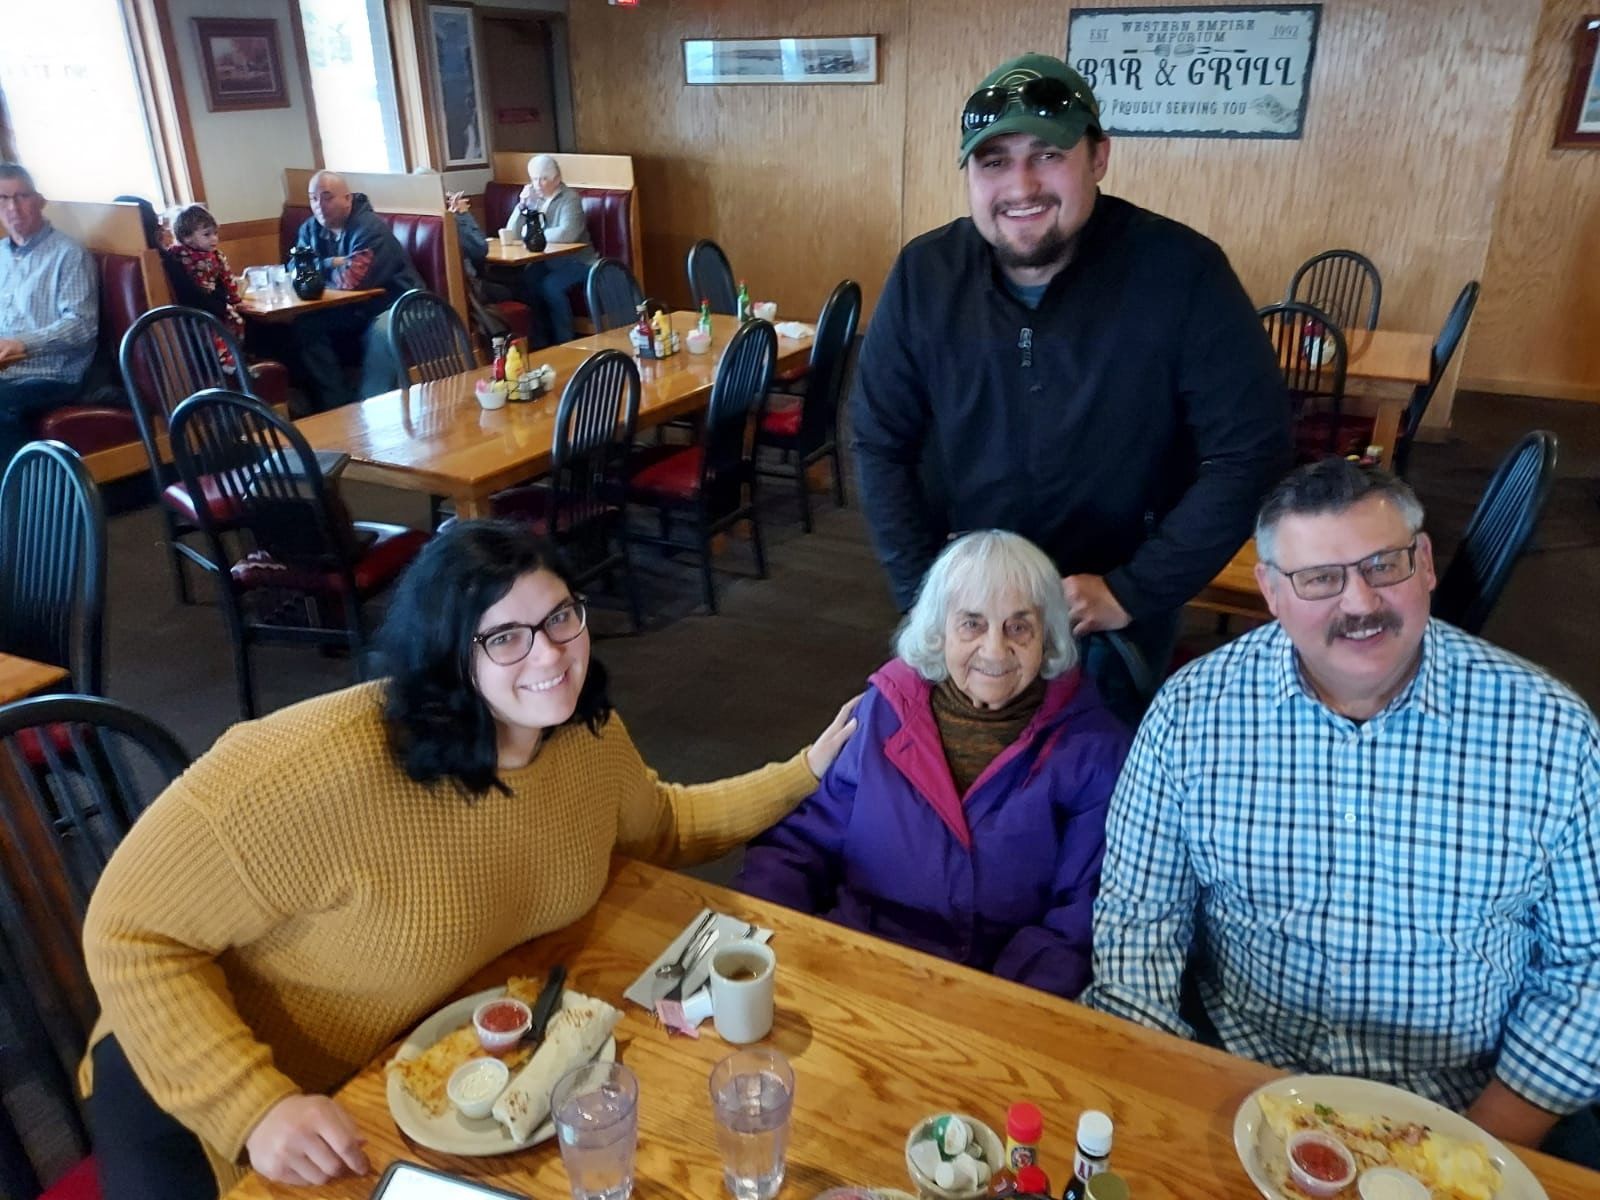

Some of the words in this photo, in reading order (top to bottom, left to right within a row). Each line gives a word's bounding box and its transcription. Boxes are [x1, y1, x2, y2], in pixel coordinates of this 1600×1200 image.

[1121, 21, 1191, 32] WESTERN
[1196, 19, 1256, 31] EMPIRE
[1090, 28, 1109, 41] EST
[1146, 32, 1226, 43] EMPORIUM
[1076, 57, 1144, 91] BAR
[1155, 58, 1178, 86] &
[1188, 56, 1297, 91] GRILL
[1111, 99, 1162, 116] PROUDLY
[1166, 101, 1218, 115] SERVING
[1222, 101, 1247, 115] YOU
